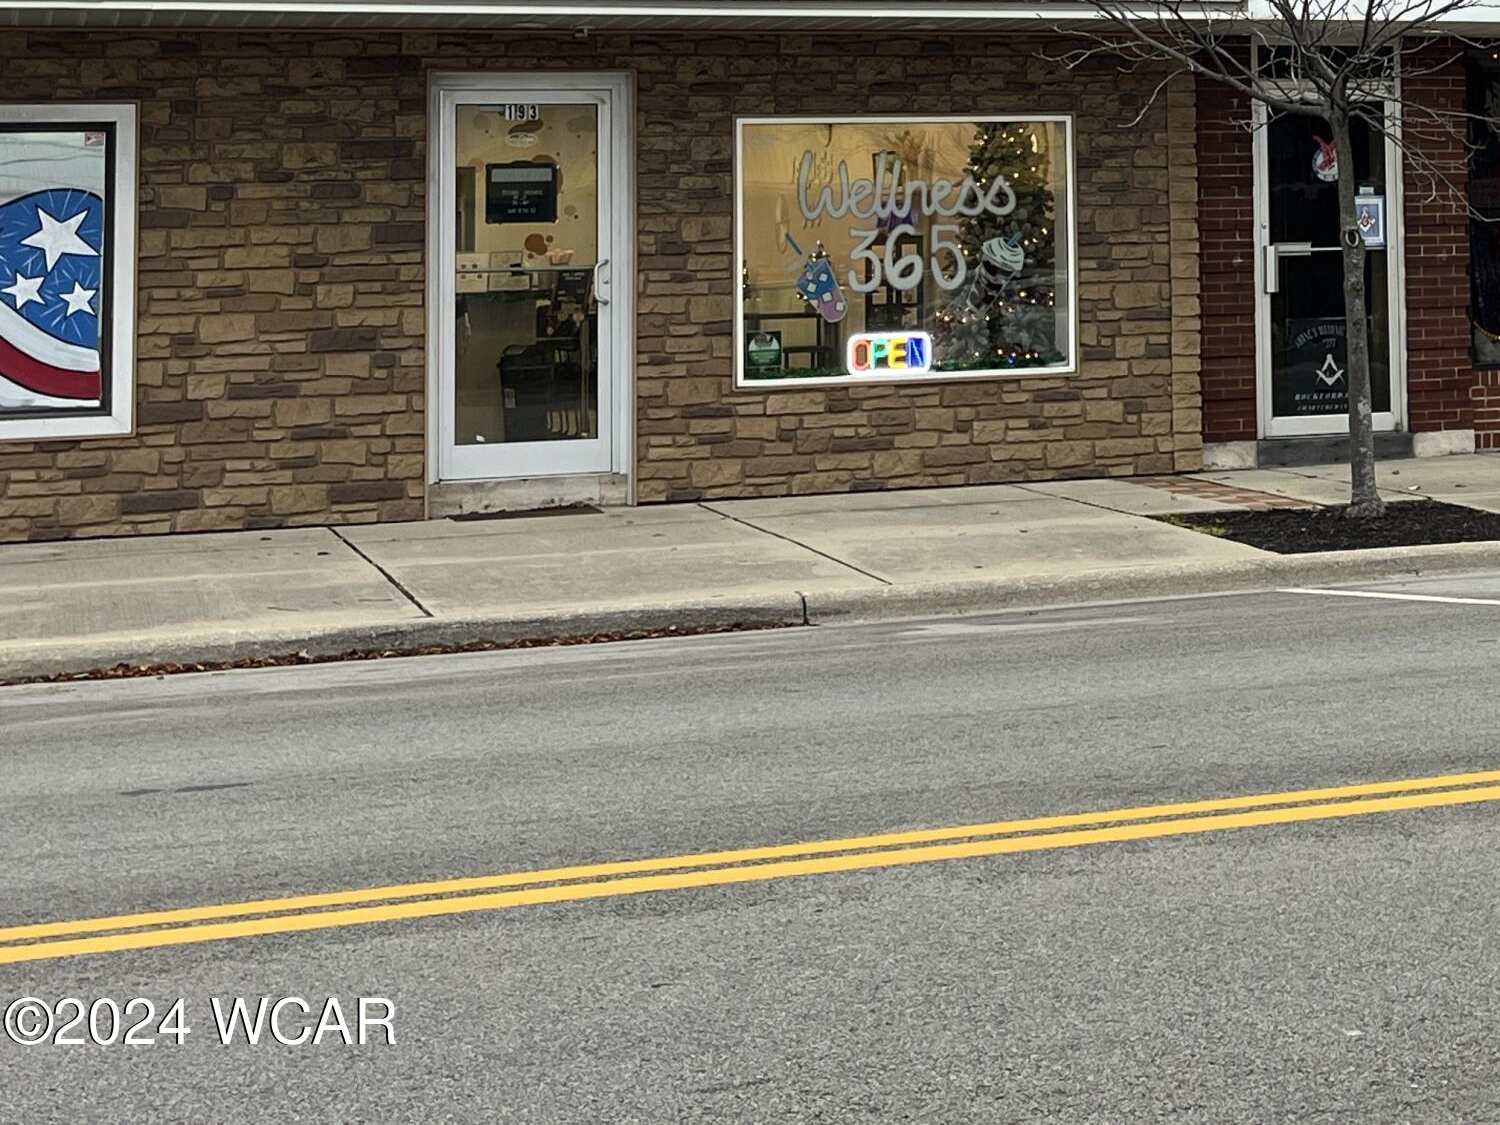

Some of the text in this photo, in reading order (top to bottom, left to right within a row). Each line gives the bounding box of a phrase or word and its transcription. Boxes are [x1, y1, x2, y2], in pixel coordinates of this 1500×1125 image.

[507, 105, 538, 119] 193
[797, 149, 1017, 221] Wellness
[848, 224, 967, 293] 365
[852, 336, 926, 371] OPEN
